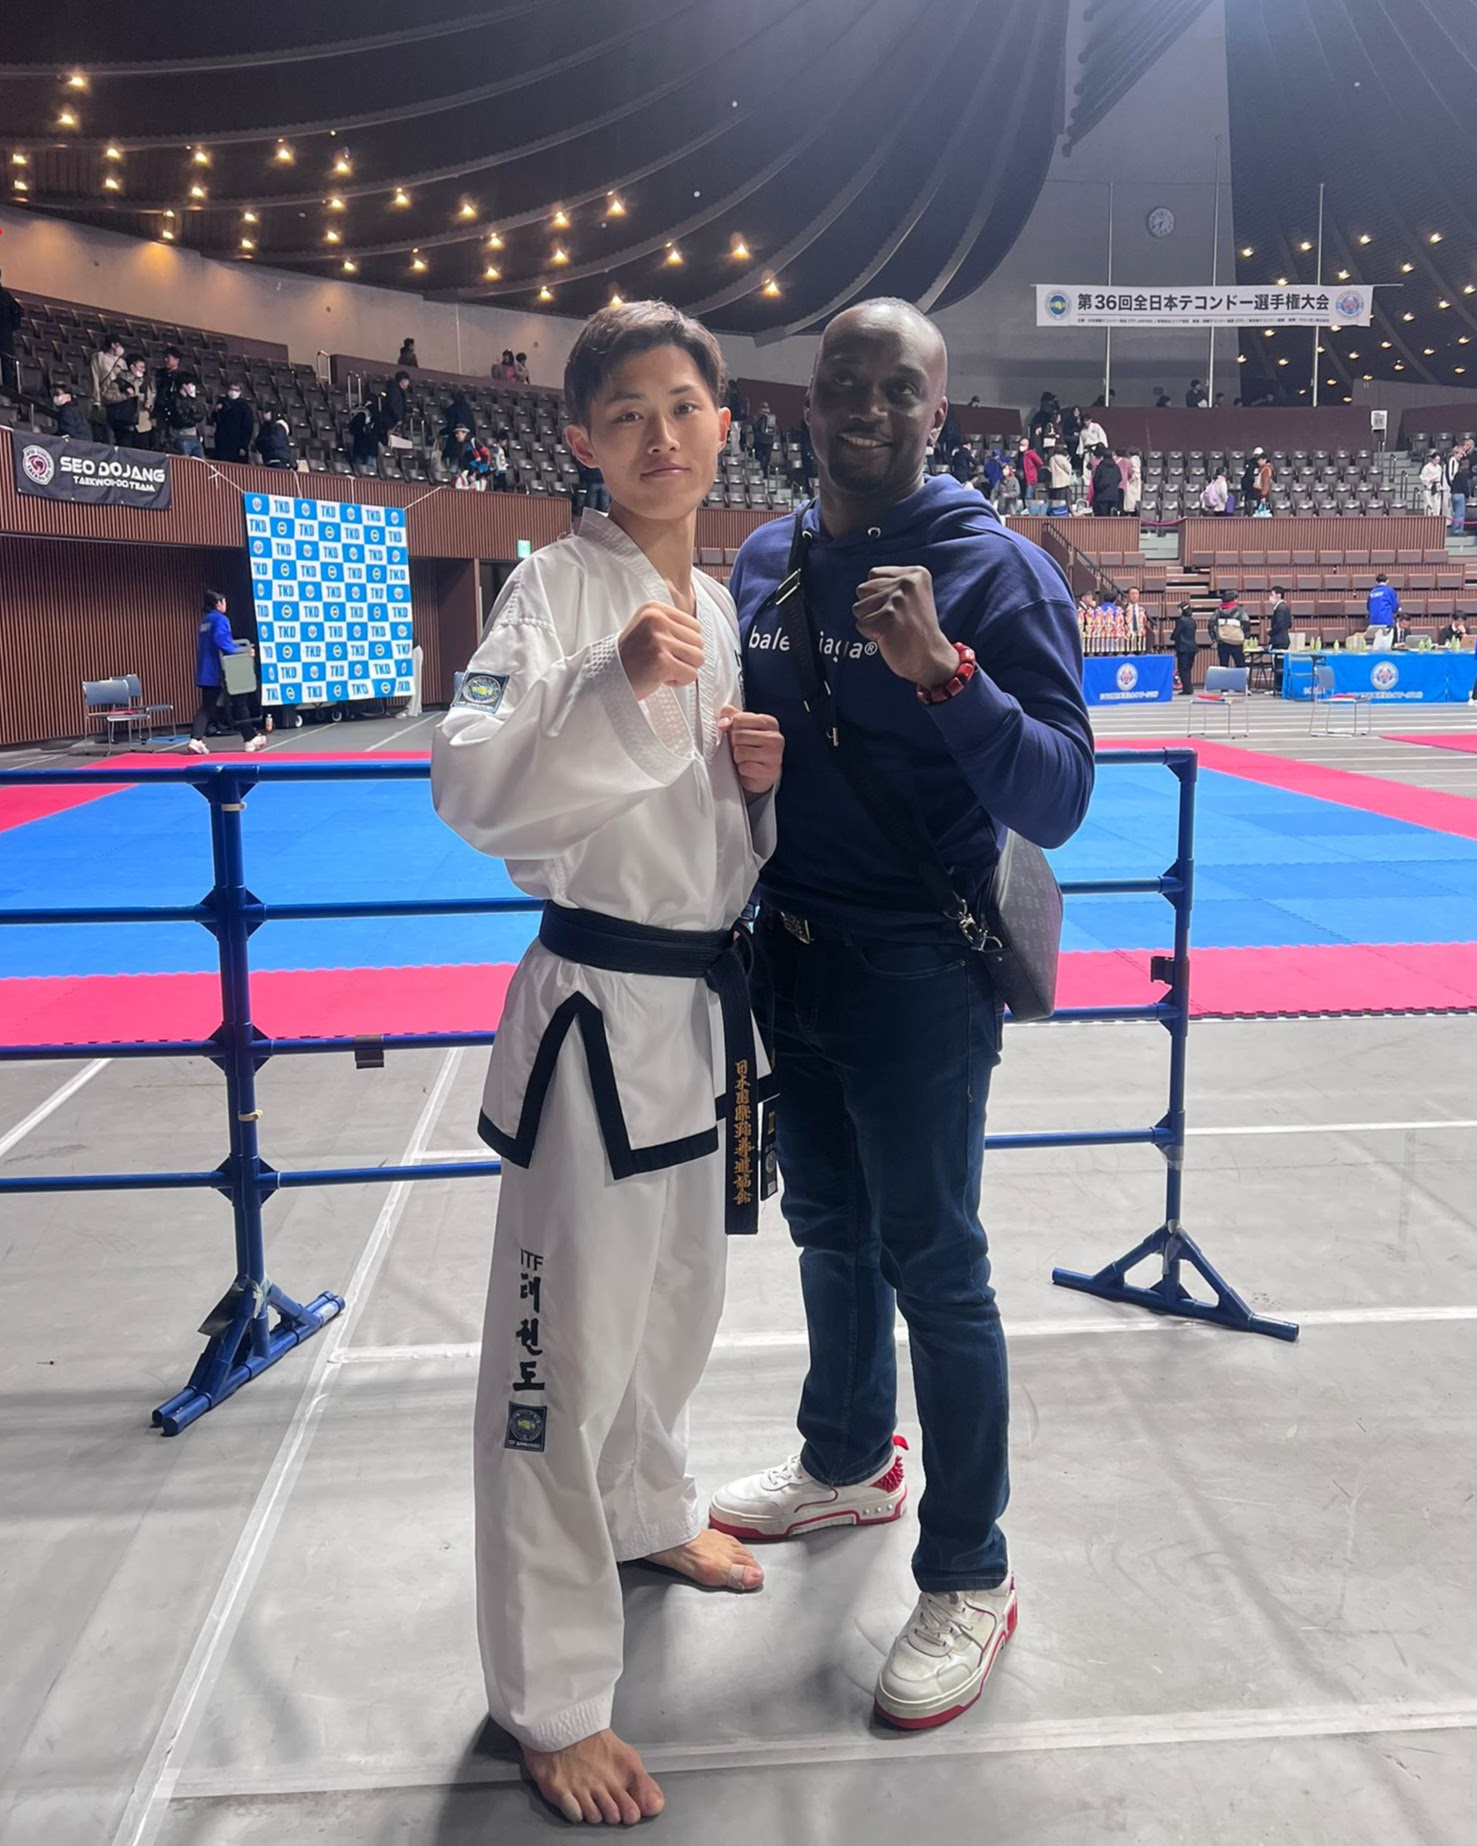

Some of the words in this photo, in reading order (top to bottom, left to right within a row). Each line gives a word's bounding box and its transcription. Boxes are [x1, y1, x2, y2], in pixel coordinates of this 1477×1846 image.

[1078, 294, 1329, 311] 第36回全日本テコンドー選手権大会
[60, 457, 95, 474] SEO
[98, 462, 165, 482] DOJANG
[130, 483, 155, 492] TEAM
[274, 501, 290, 513] TKD
[322, 506, 335, 518] TKD
[366, 510, 380, 521] TKD
[250, 520, 266, 532] TKD
[300, 524, 314, 536] TKD
[345, 528, 359, 539] TKD
[276, 544, 291, 555] TKD
[324, 547, 338, 558] TKD
[369, 550, 383, 560] TKD
[301, 566, 316, 577] TKD
[348, 568, 362, 579] TKD
[389, 569, 405, 580] TKD
[278, 585, 294, 596] TKD
[327, 587, 341, 597] TKD
[304, 606, 318, 617] TKD
[350, 607, 363, 617] TKD
[392, 607, 408, 617] TKD
[329, 627, 342, 637] TKD
[371, 626, 385, 637] TKD
[306, 646, 321, 657] TKD
[351, 645, 365, 656] TKD
[281, 667, 296, 678] TKD
[374, 664, 391, 674] TKD
[307, 686, 322, 697] TKD
[352, 684, 368, 694] TKD
[520, 1248, 543, 1271] ITF
